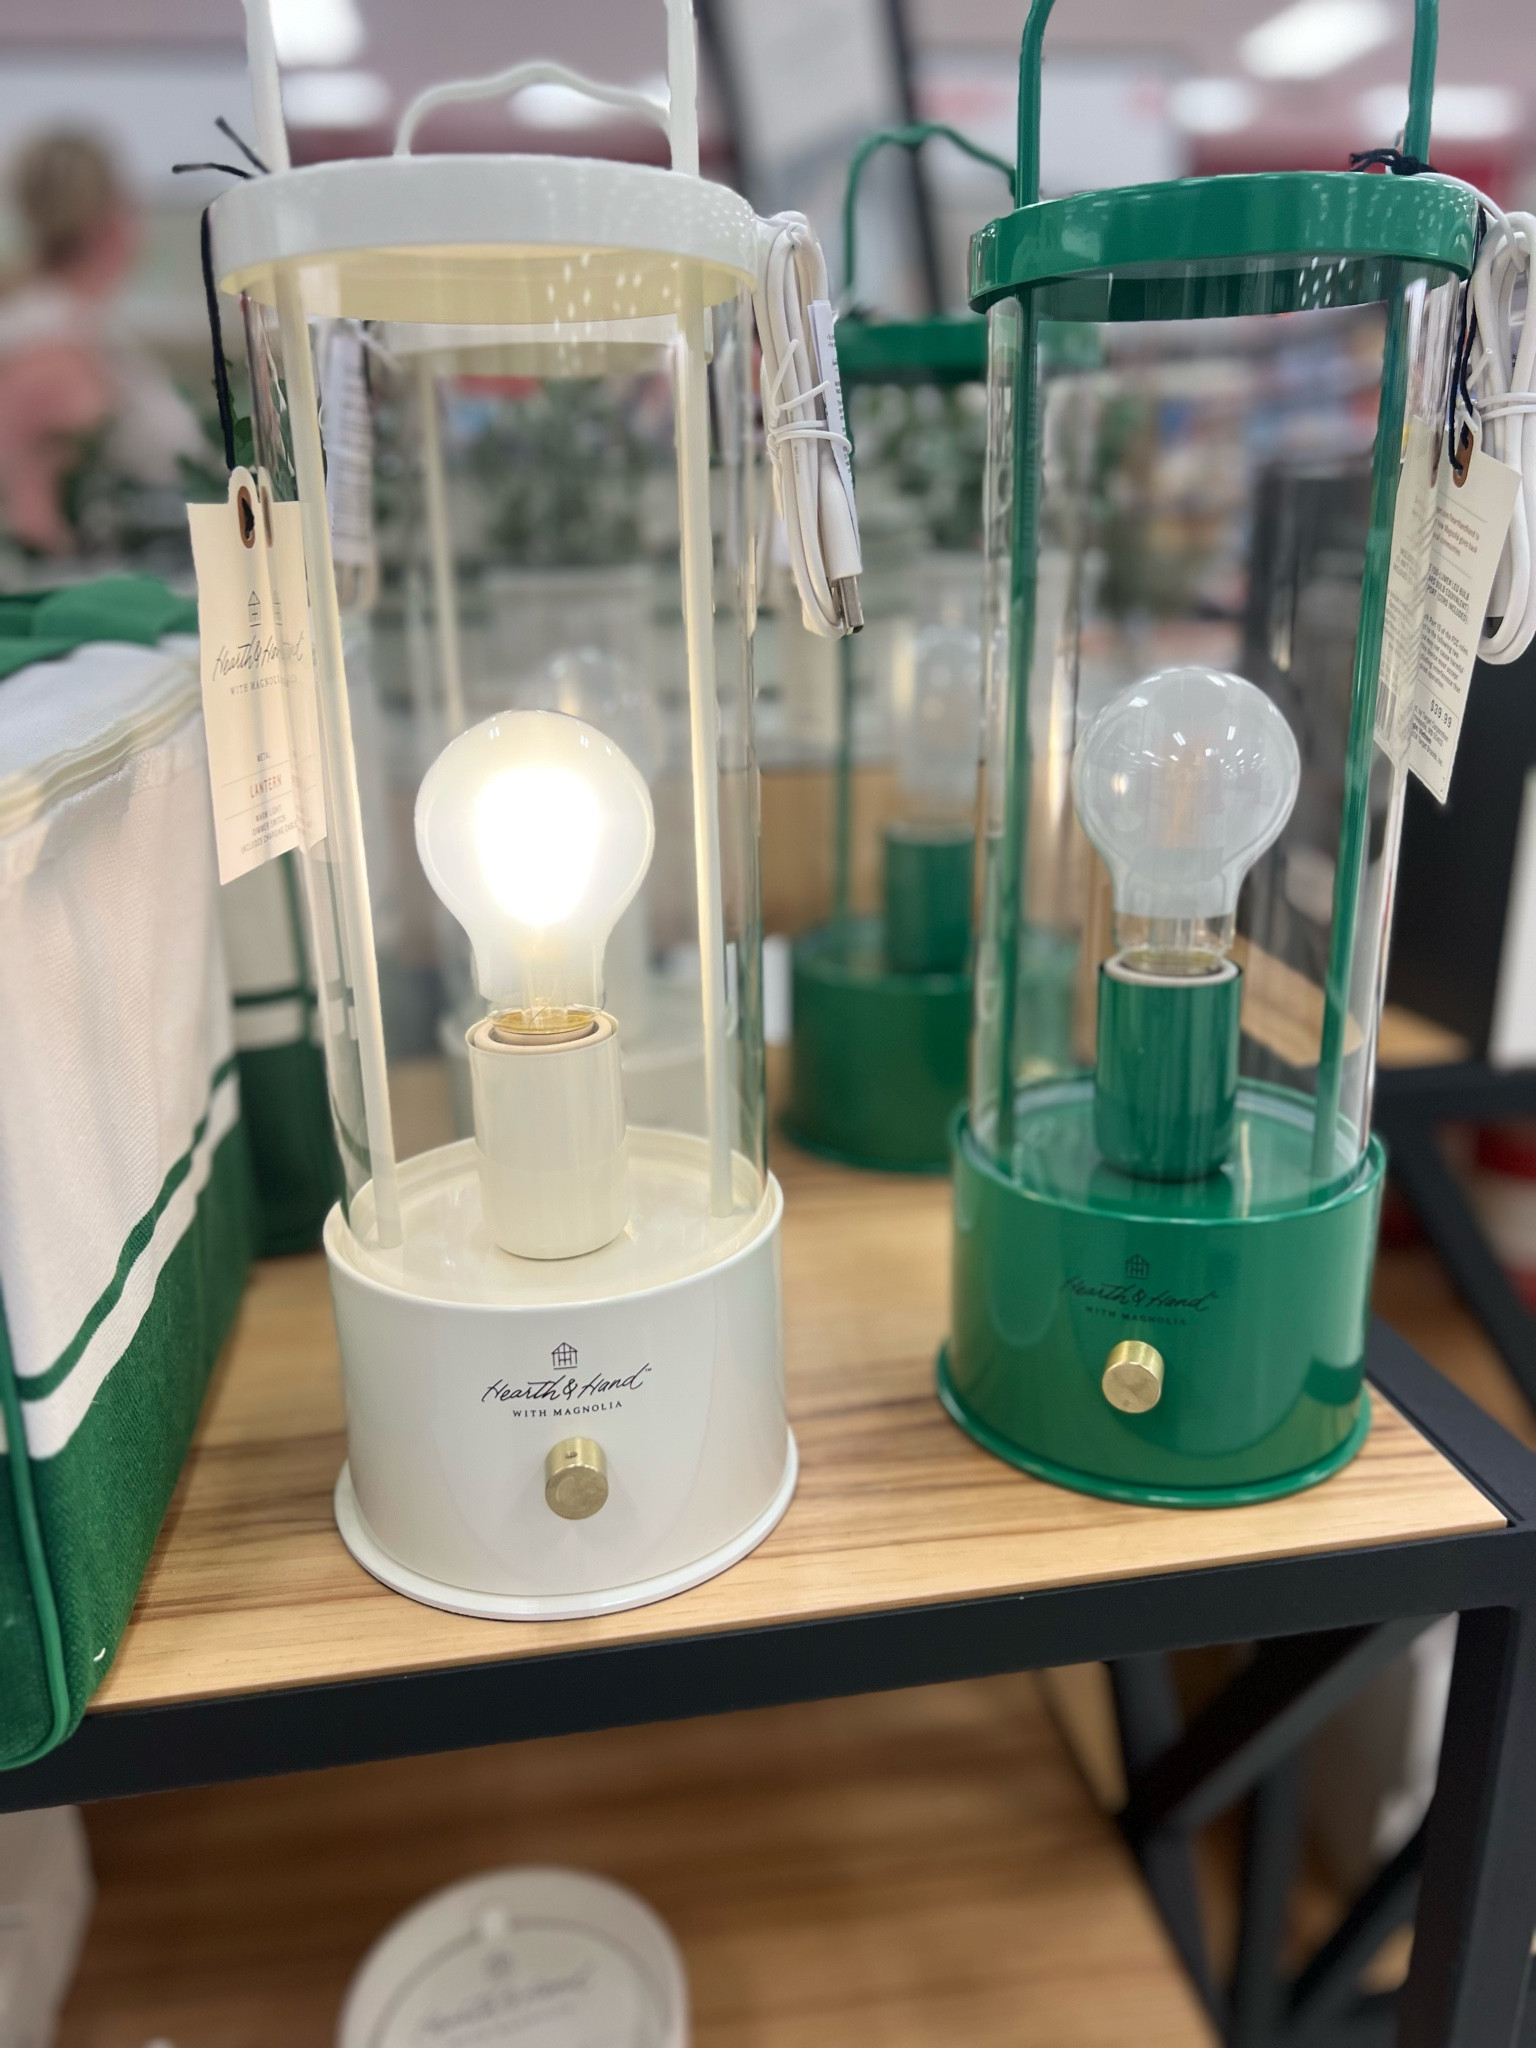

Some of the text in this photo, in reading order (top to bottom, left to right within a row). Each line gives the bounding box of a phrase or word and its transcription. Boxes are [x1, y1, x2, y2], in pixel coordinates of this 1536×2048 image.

[1430, 699, 1452, 728] $39.99
[250, 774, 282, 798] LANTERN
[1059, 1276, 1136, 1305] Hearth
[1131, 1288, 1147, 1307] &
[1085, 1306, 1187, 1325] WITH MAGNOLIA
[481, 1375, 566, 1402] Hearth
[562, 1378, 578, 1400] &
[512, 1400, 623, 1418] WITH MAGNOLIA
